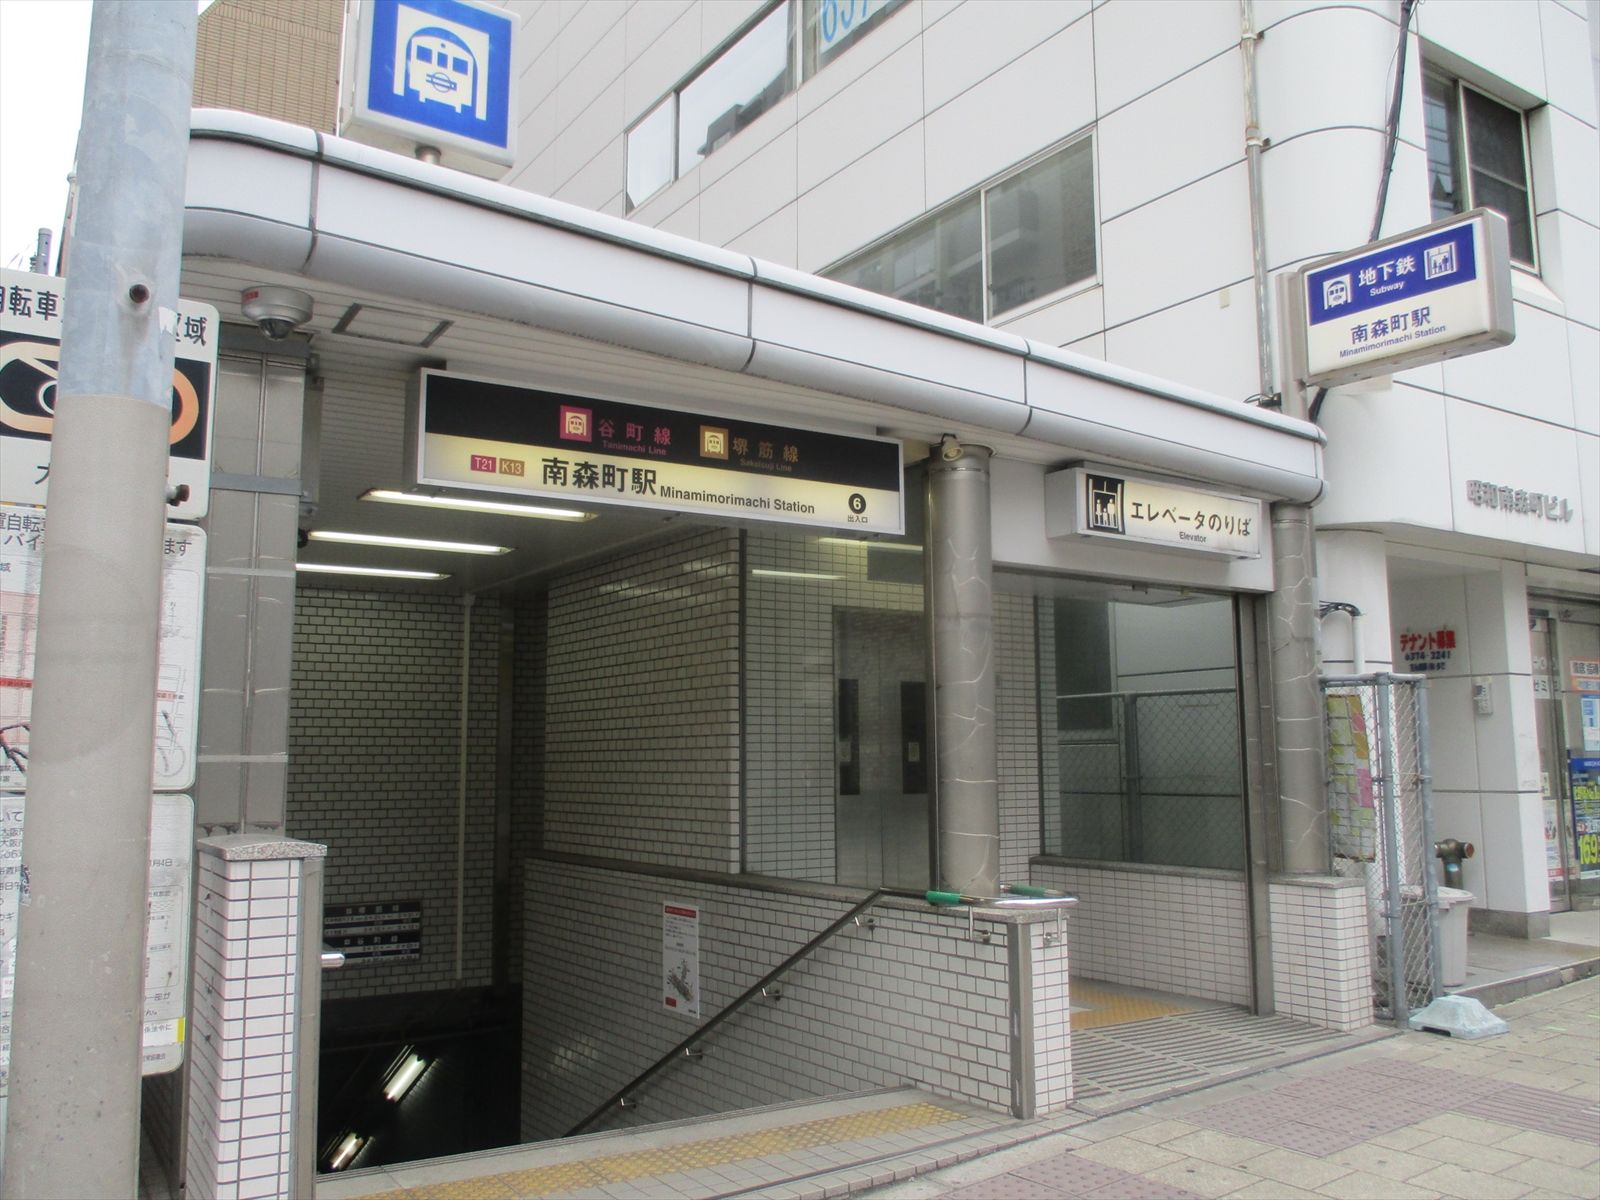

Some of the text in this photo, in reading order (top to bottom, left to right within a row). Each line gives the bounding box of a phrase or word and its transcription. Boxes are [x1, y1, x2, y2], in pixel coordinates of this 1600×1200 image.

[1358, 254, 1416, 287] 地下鉄
[1369, 280, 1405, 297] Subway
[0, 285, 66, 322] 転車
[1350, 306, 1431, 345] 南森町駅
[1339, 324, 1447, 358] Minamimorimachi Station
[598, 418, 672, 446] 谷町線
[648, 443, 667, 456] Line
[732, 436, 800, 464] 堺筋線
[473, 457, 522, 474] T21 K13
[541, 456, 657, 495] 南森町駅
[660, 485, 815, 514] Minamimorimachi Station
[0, 512, 46, 533] 自転
[847, 514, 869, 523] 出入口
[1130, 502, 1251, 537] エレベータのりば
[4, 534, 45, 551] バイ
[164, 538, 192, 556] ます
[1179, 531, 1207, 543] Elevator
